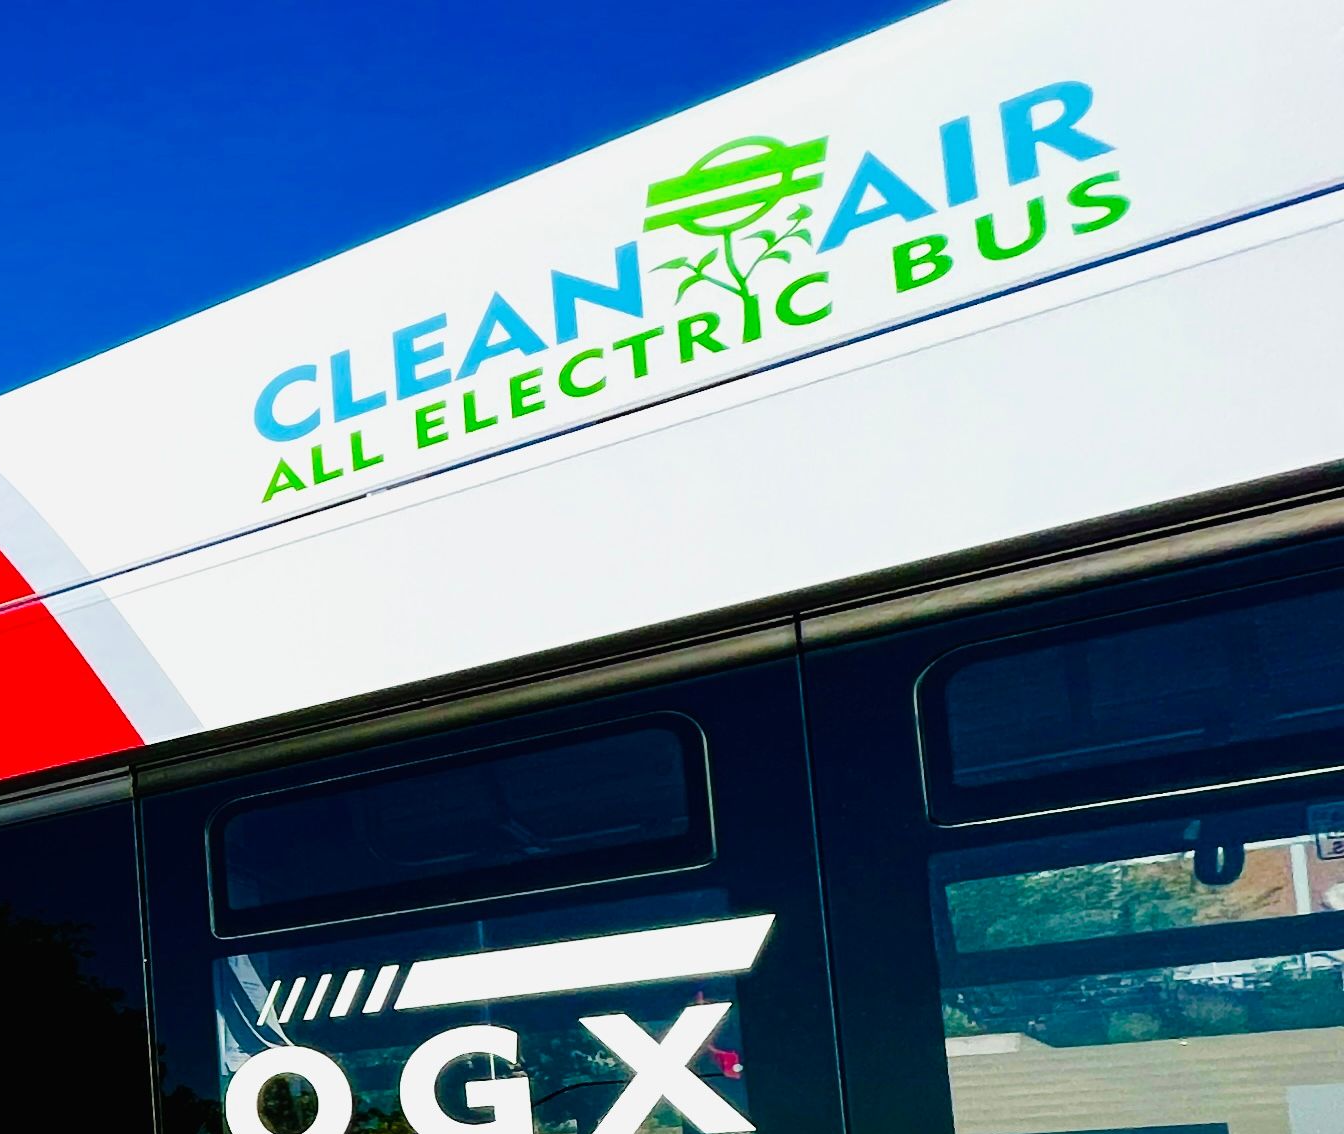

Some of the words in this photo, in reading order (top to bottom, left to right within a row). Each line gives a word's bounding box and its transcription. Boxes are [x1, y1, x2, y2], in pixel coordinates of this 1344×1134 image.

[253, 240, 645, 444] CLEAN
[817, 79, 1117, 254] AIR
[262, 430, 385, 503] ALL
[414, 271, 834, 450] ELECTRIC
[891, 170, 1131, 294] BUS
